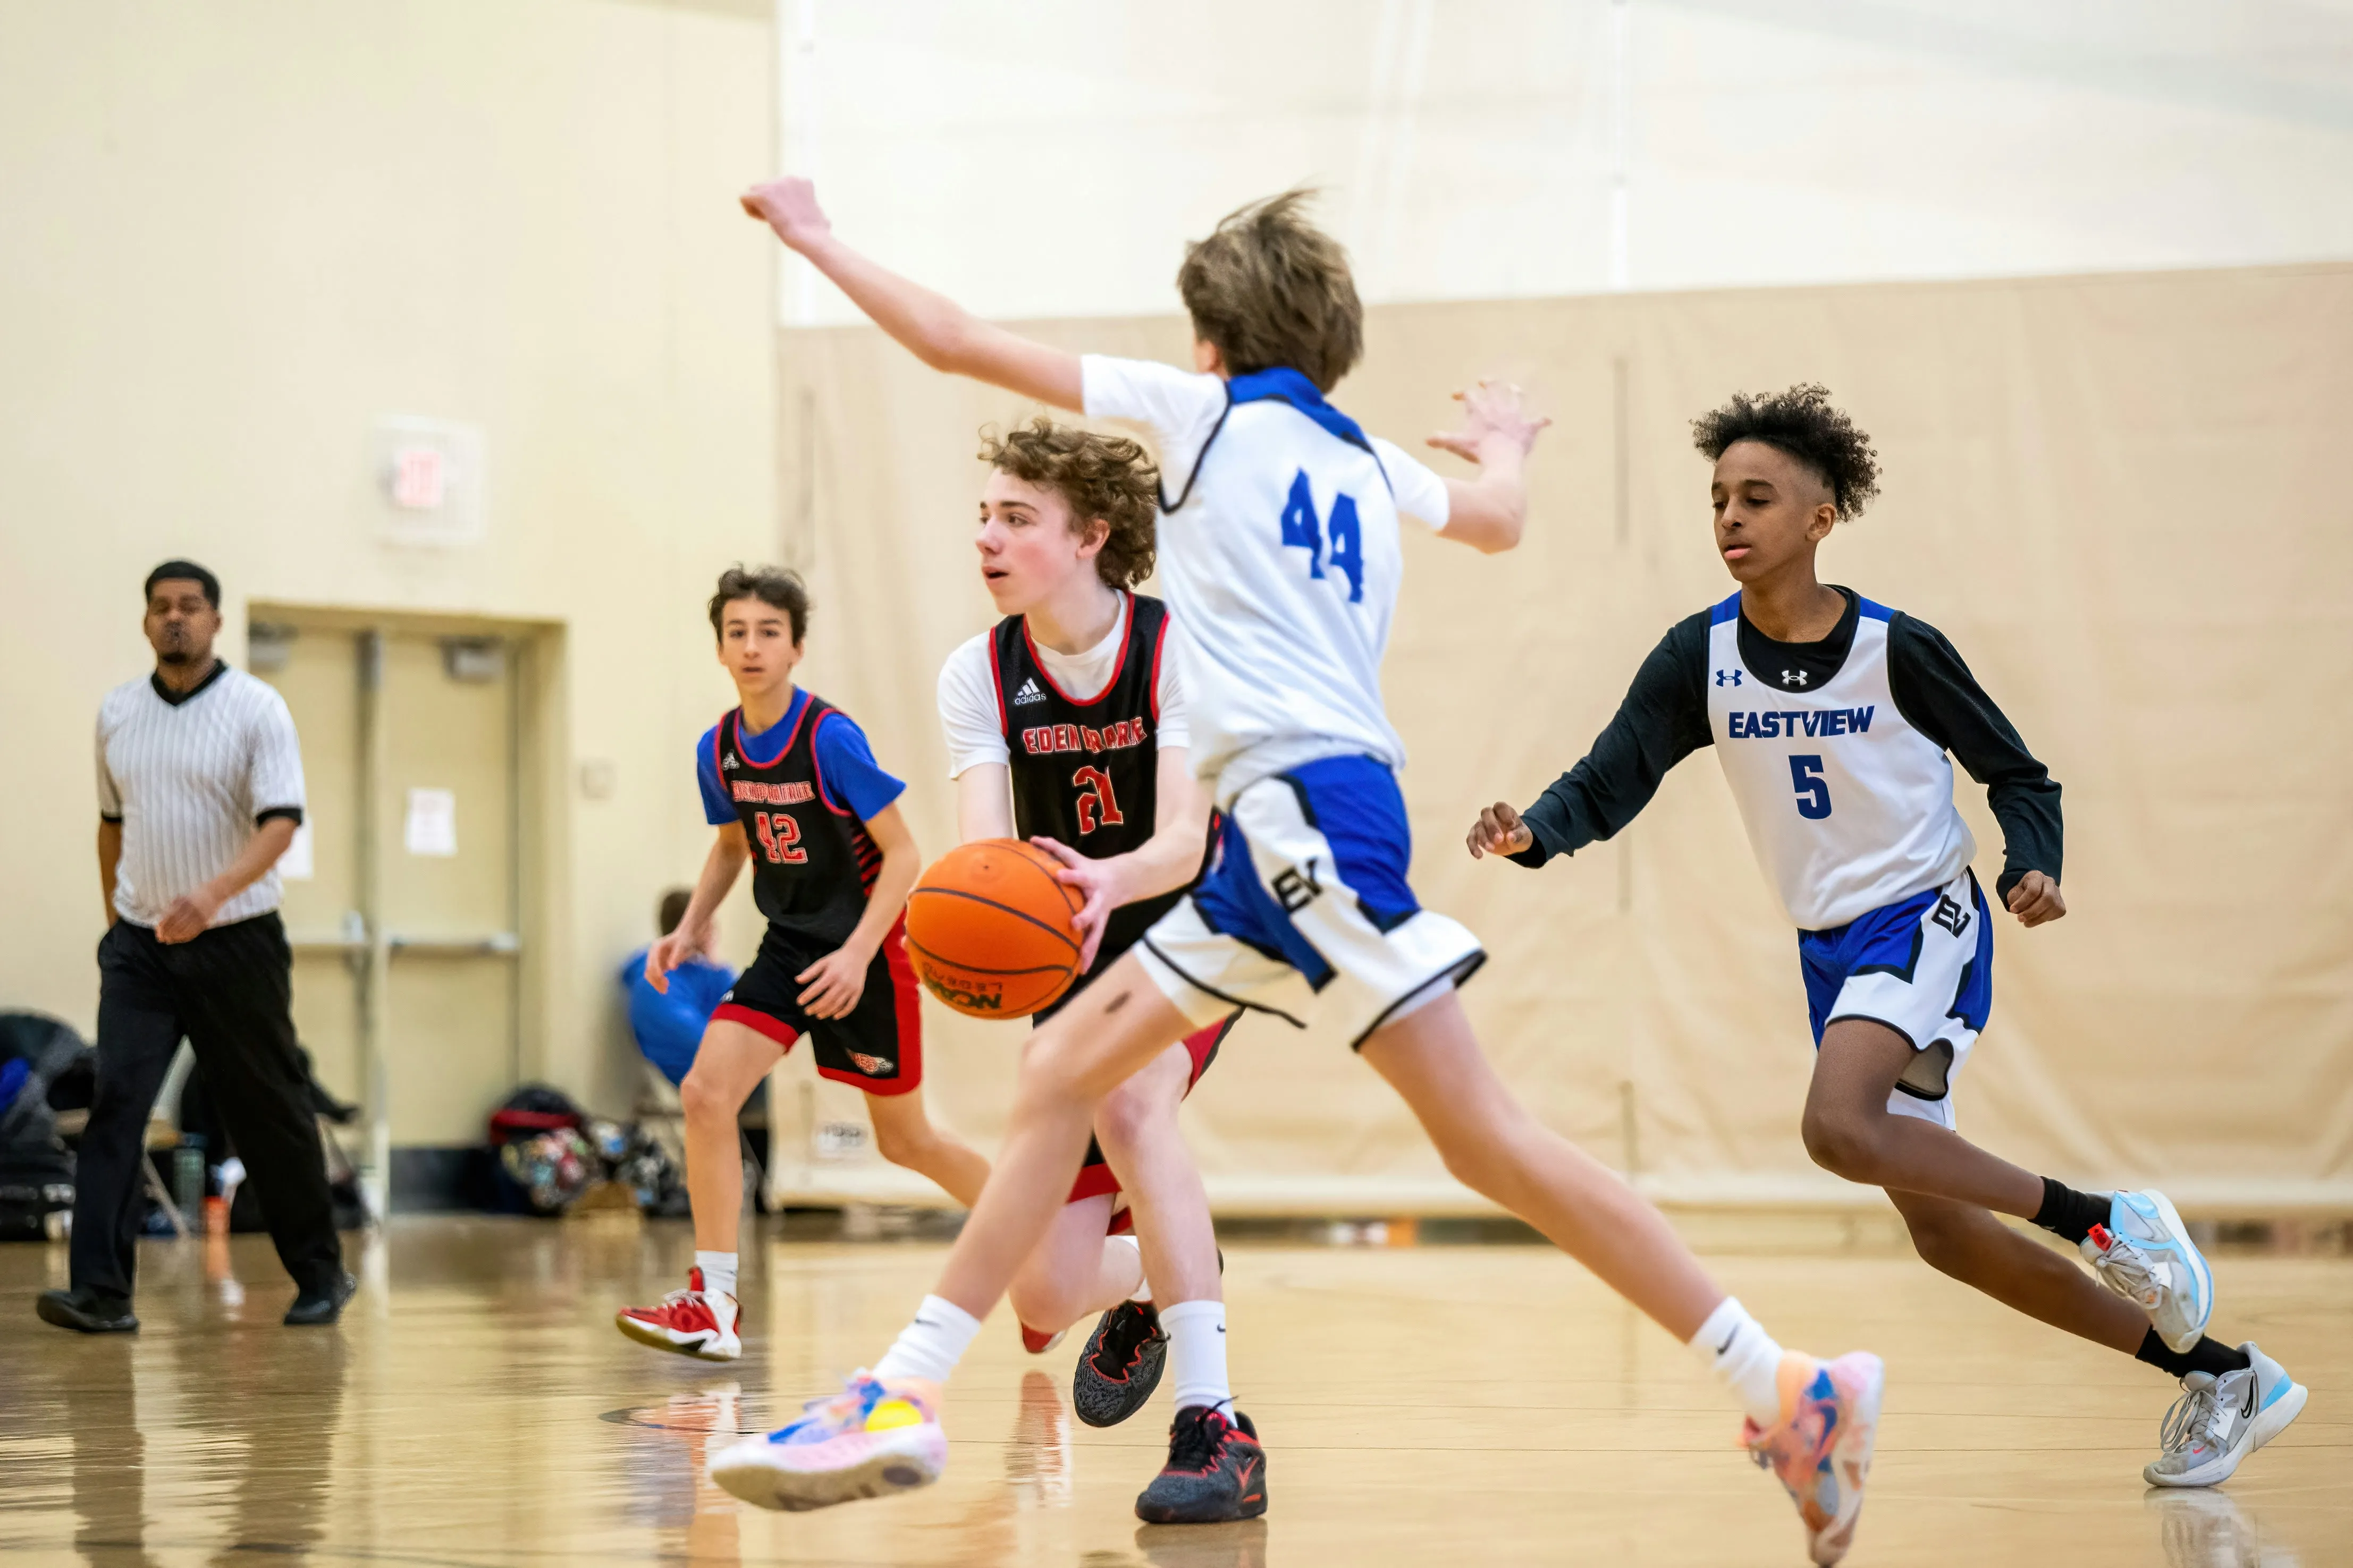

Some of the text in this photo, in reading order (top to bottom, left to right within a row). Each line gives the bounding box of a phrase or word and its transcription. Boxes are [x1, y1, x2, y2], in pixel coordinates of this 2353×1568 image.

[1280, 465, 1364, 603] 44
[1014, 693, 1047, 705] adidas
[1728, 705, 1875, 739] EASTVIEW
[1073, 765, 1124, 835] 21
[1788, 755, 1832, 820] 5
[755, 811, 808, 864] 42
[1930, 894, 1971, 939] EV
